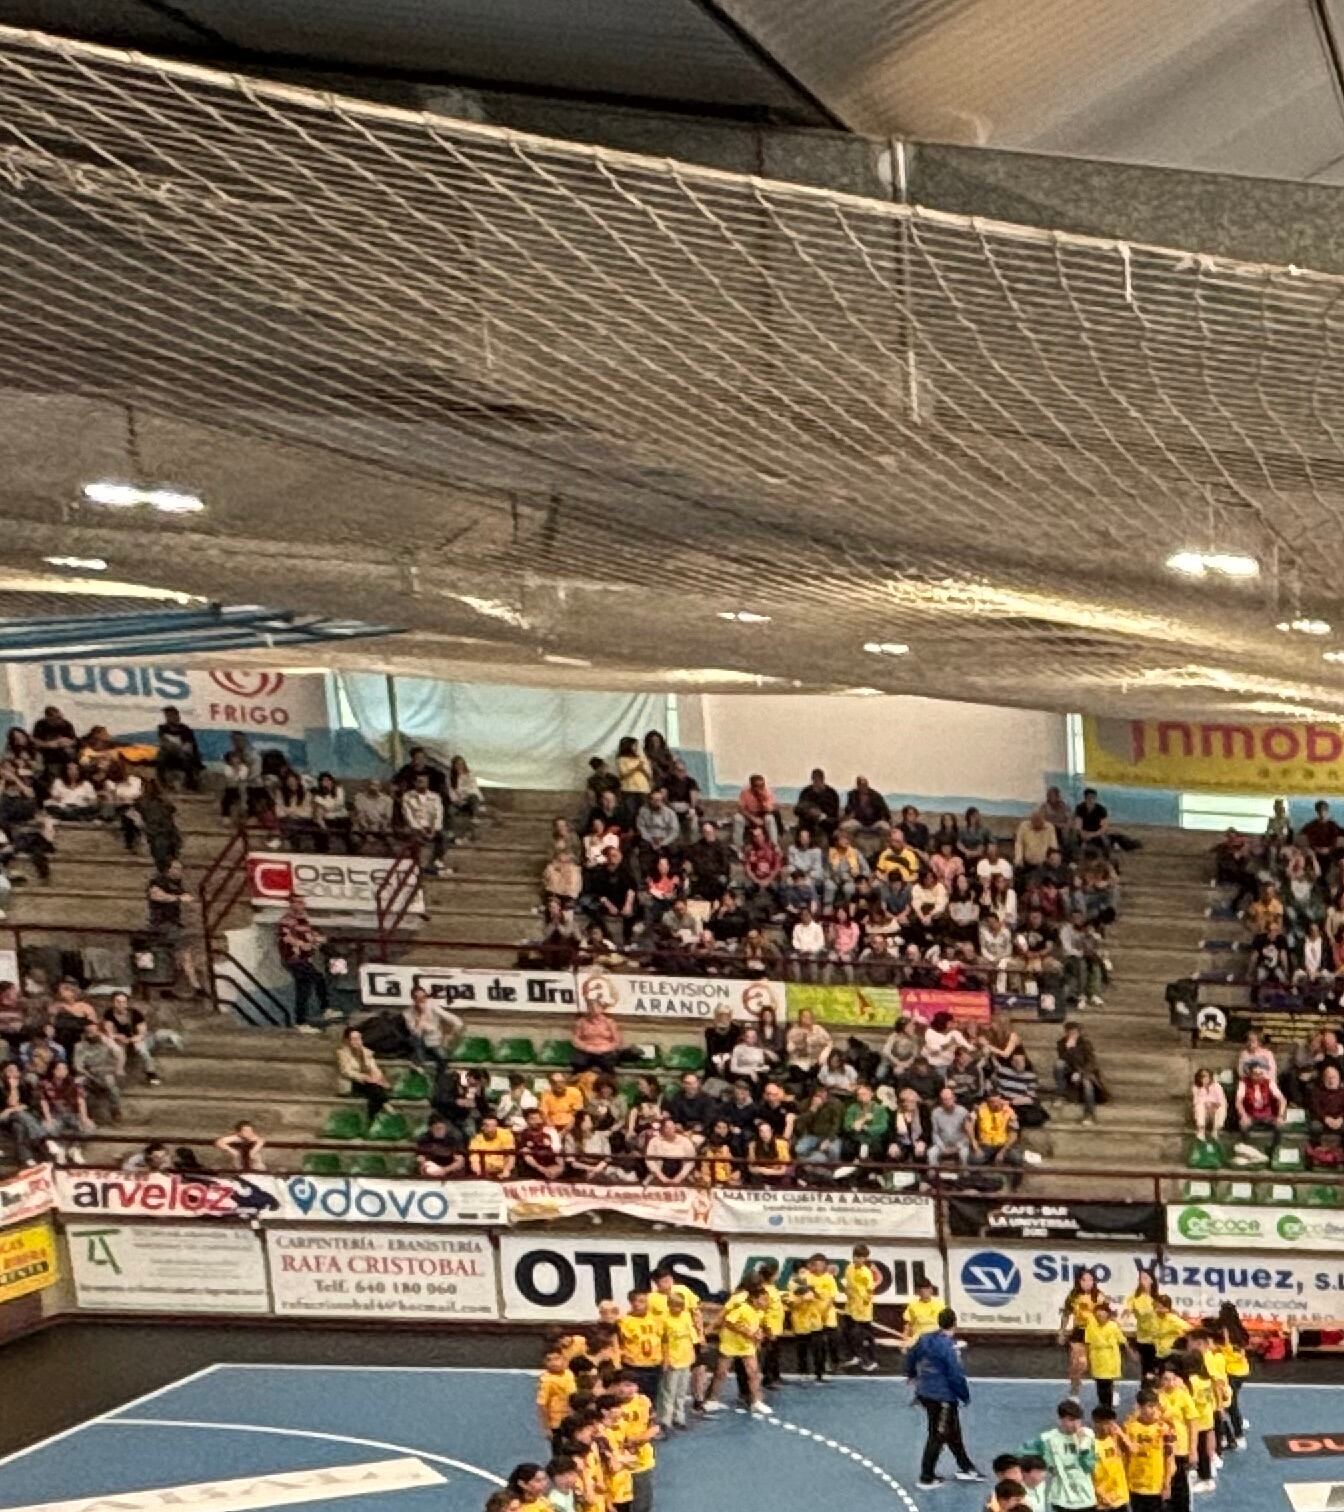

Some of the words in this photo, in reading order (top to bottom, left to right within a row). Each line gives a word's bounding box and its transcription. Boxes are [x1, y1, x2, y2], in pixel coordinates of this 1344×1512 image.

[210, 703, 290, 726] FRIGO
[487, 979, 517, 1001] de
[527, 978, 574, 1004] Oro
[281, 1254, 342, 1273] RAFA
[347, 1256, 485, 1277] CRISTOBAL
[515, 1249, 716, 1306] OTIS
